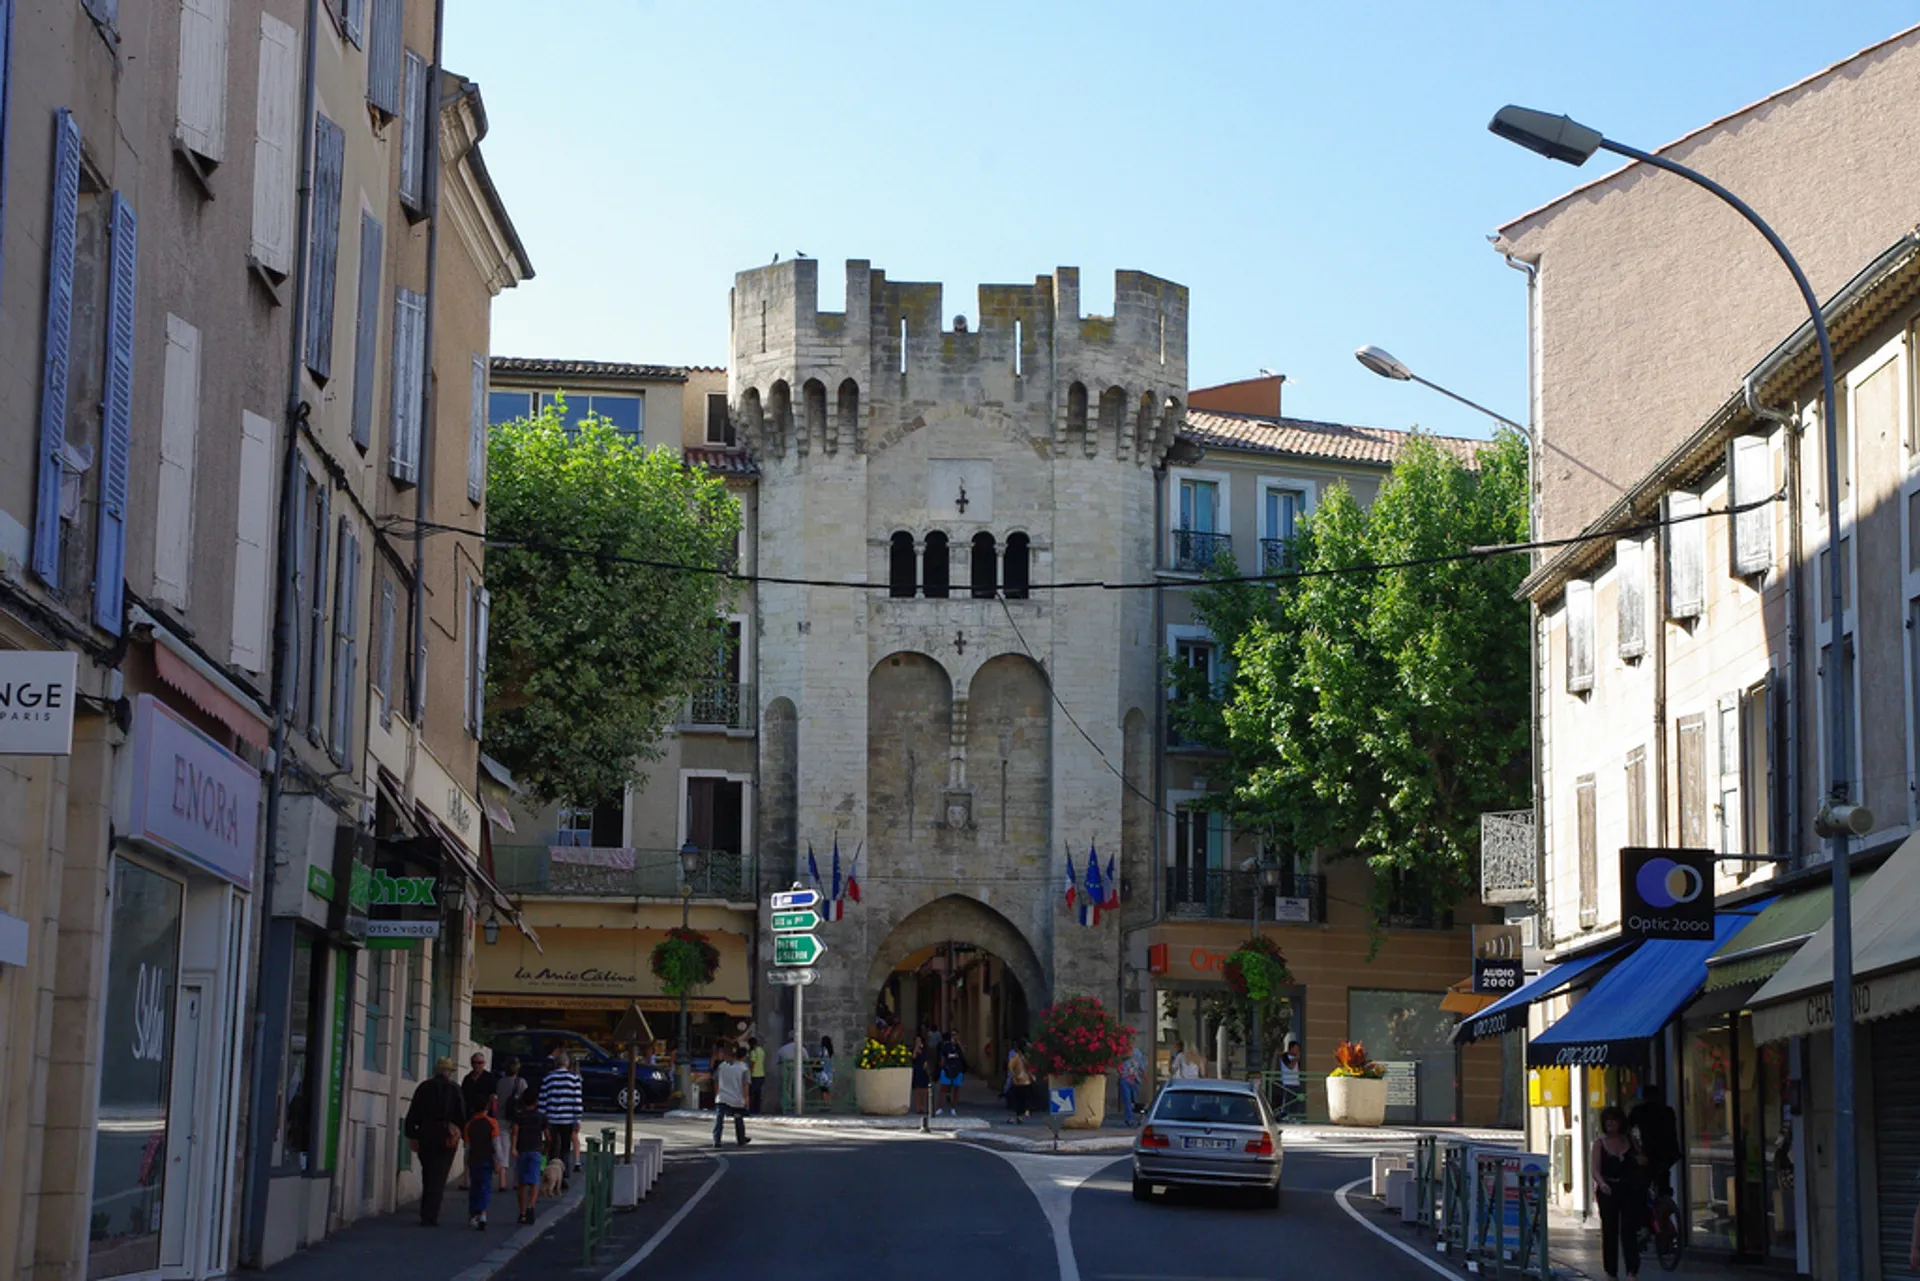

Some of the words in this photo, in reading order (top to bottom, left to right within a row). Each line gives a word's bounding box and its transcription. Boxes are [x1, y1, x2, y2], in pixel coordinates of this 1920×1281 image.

[172, 753, 240, 848] ENORA
[1627, 915, 1671, 933] Optic
[1672, 918, 1710, 932] 2000
[1482, 968, 1516, 978] AUDIO
[1482, 978, 1515, 988] 2000
